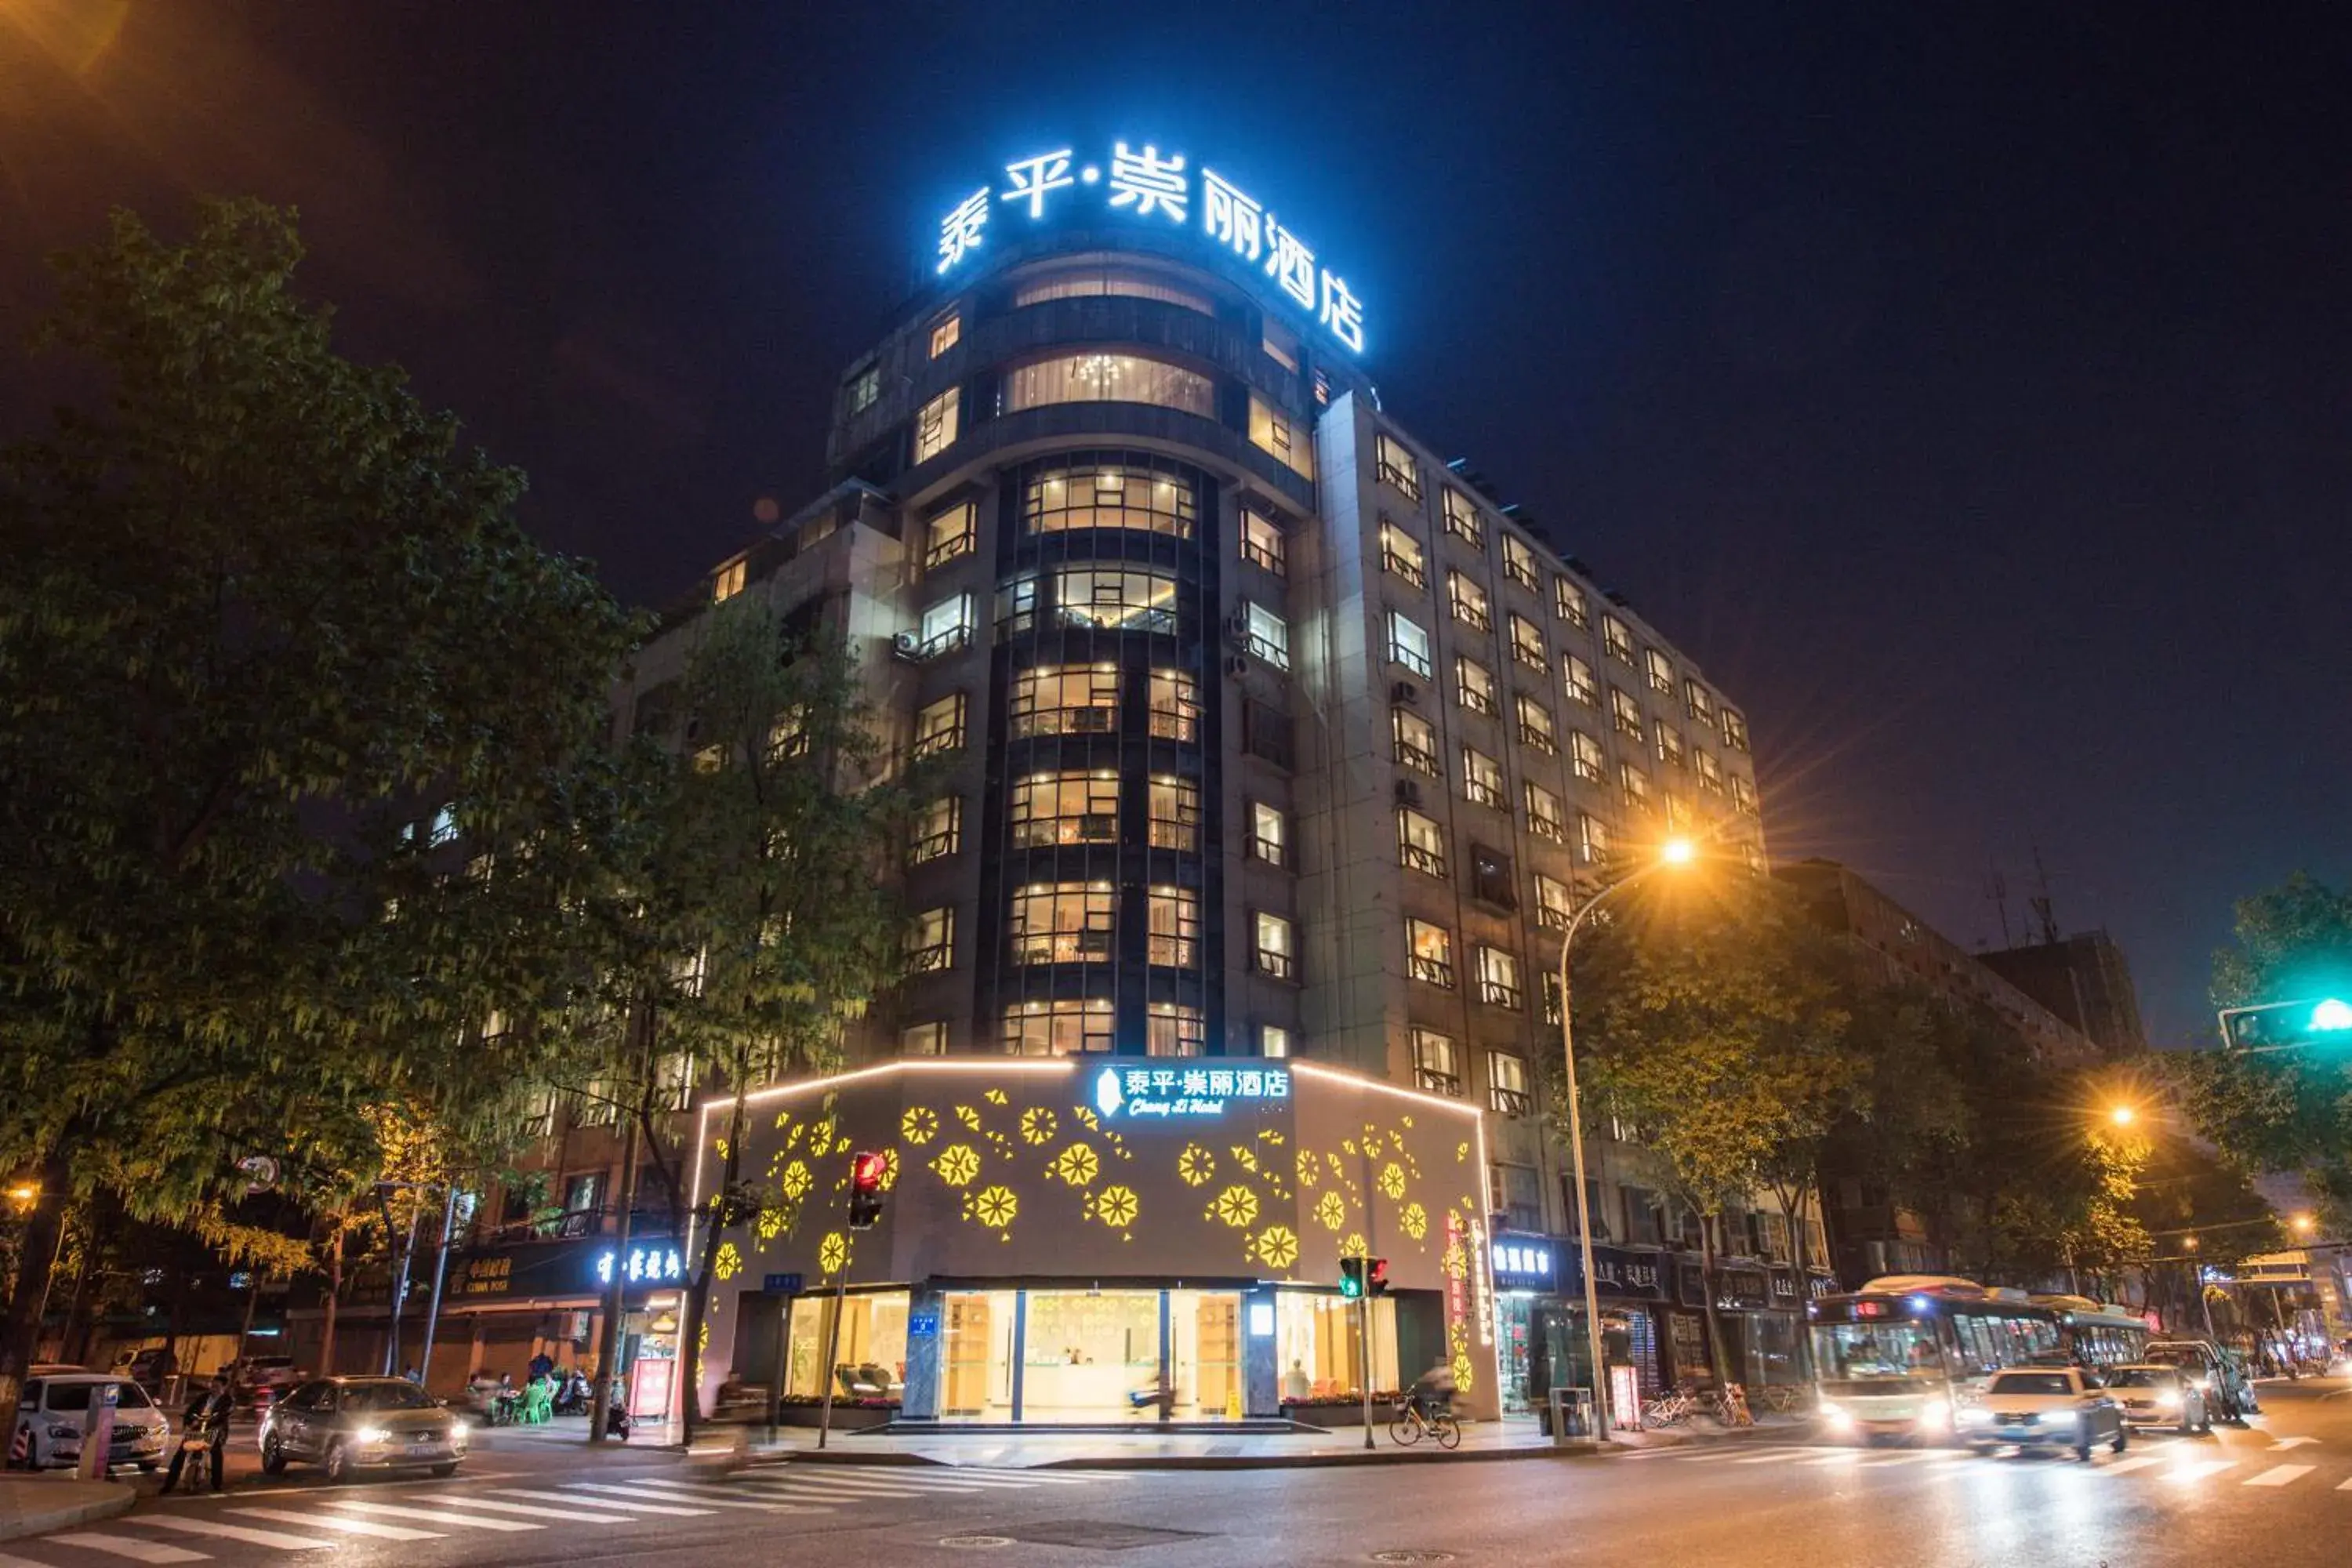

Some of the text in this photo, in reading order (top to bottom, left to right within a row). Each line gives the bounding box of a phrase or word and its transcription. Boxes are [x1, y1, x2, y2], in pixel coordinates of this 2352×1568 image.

[936, 141, 1363, 353] 泰平·崇丽酒店
[1126, 1070, 1289, 1097] 泰平·崇丽酒店
